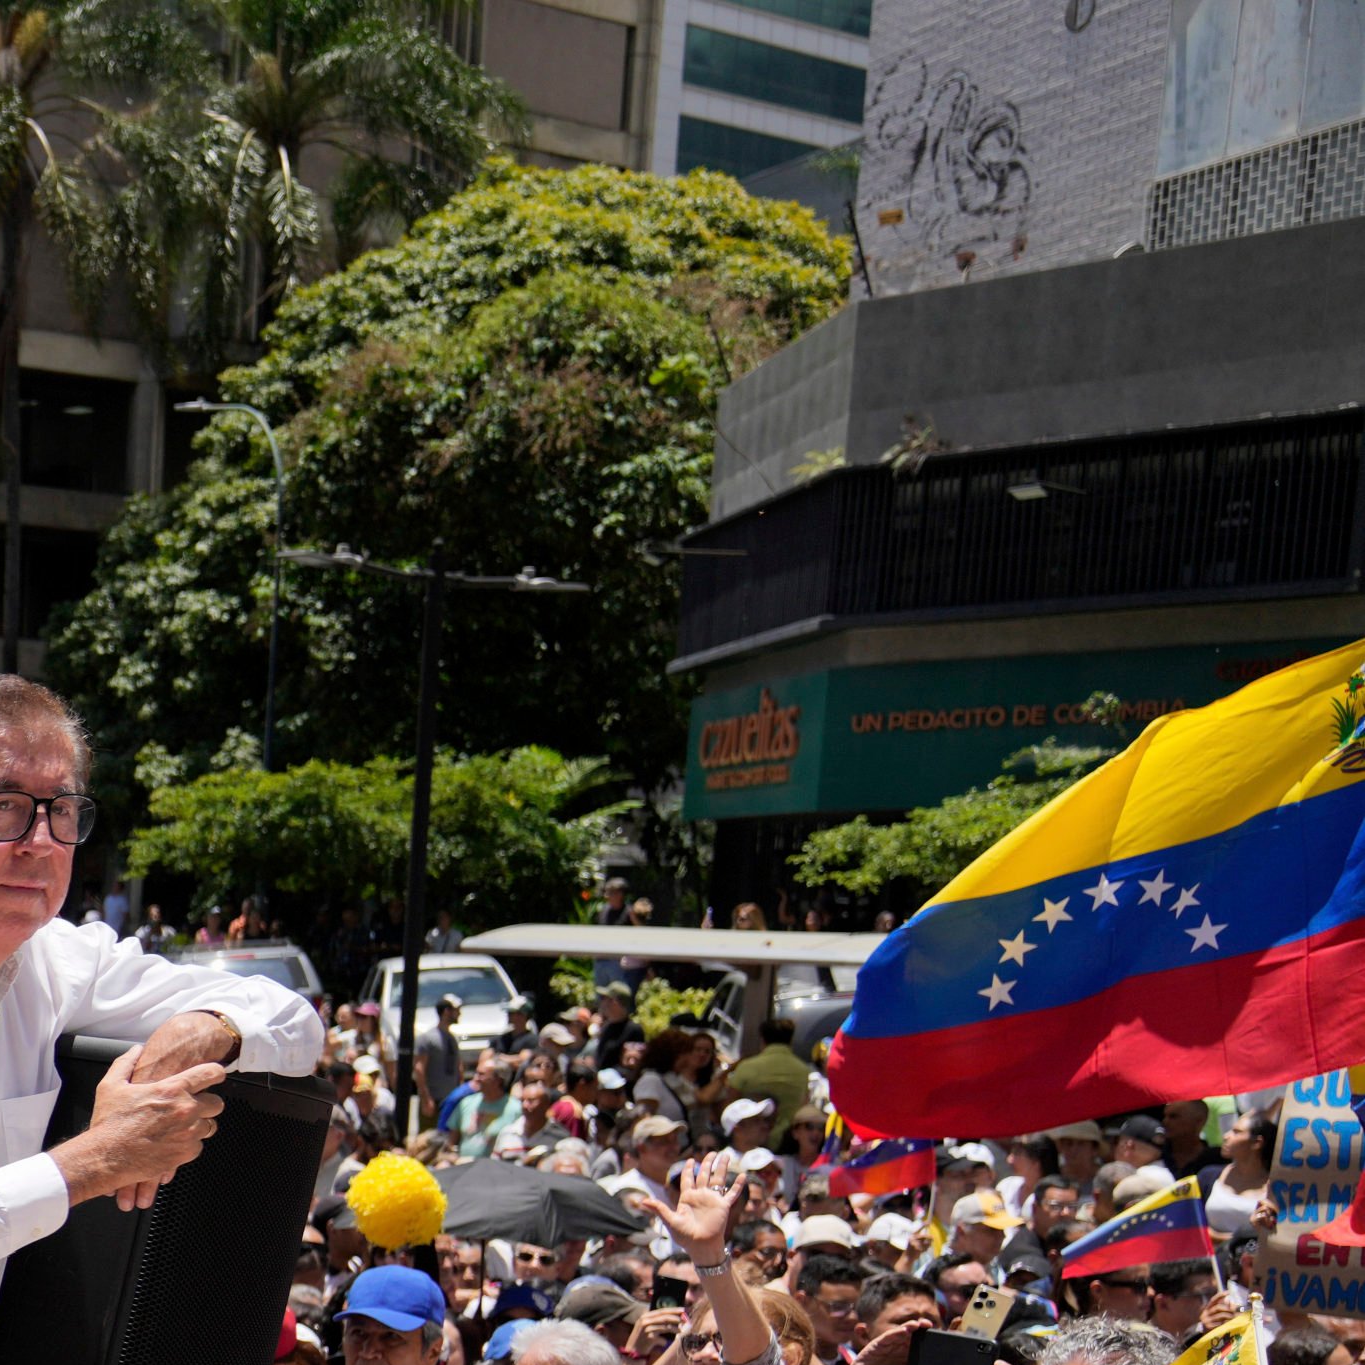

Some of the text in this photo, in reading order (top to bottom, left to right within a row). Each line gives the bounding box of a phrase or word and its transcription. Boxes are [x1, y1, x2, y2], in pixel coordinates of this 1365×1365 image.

[852, 711, 883, 733] UN
[888, 705, 1006, 731] PEDACITO
[1012, 703, 1047, 726] DE
[1279, 1117, 1365, 1170] EST
